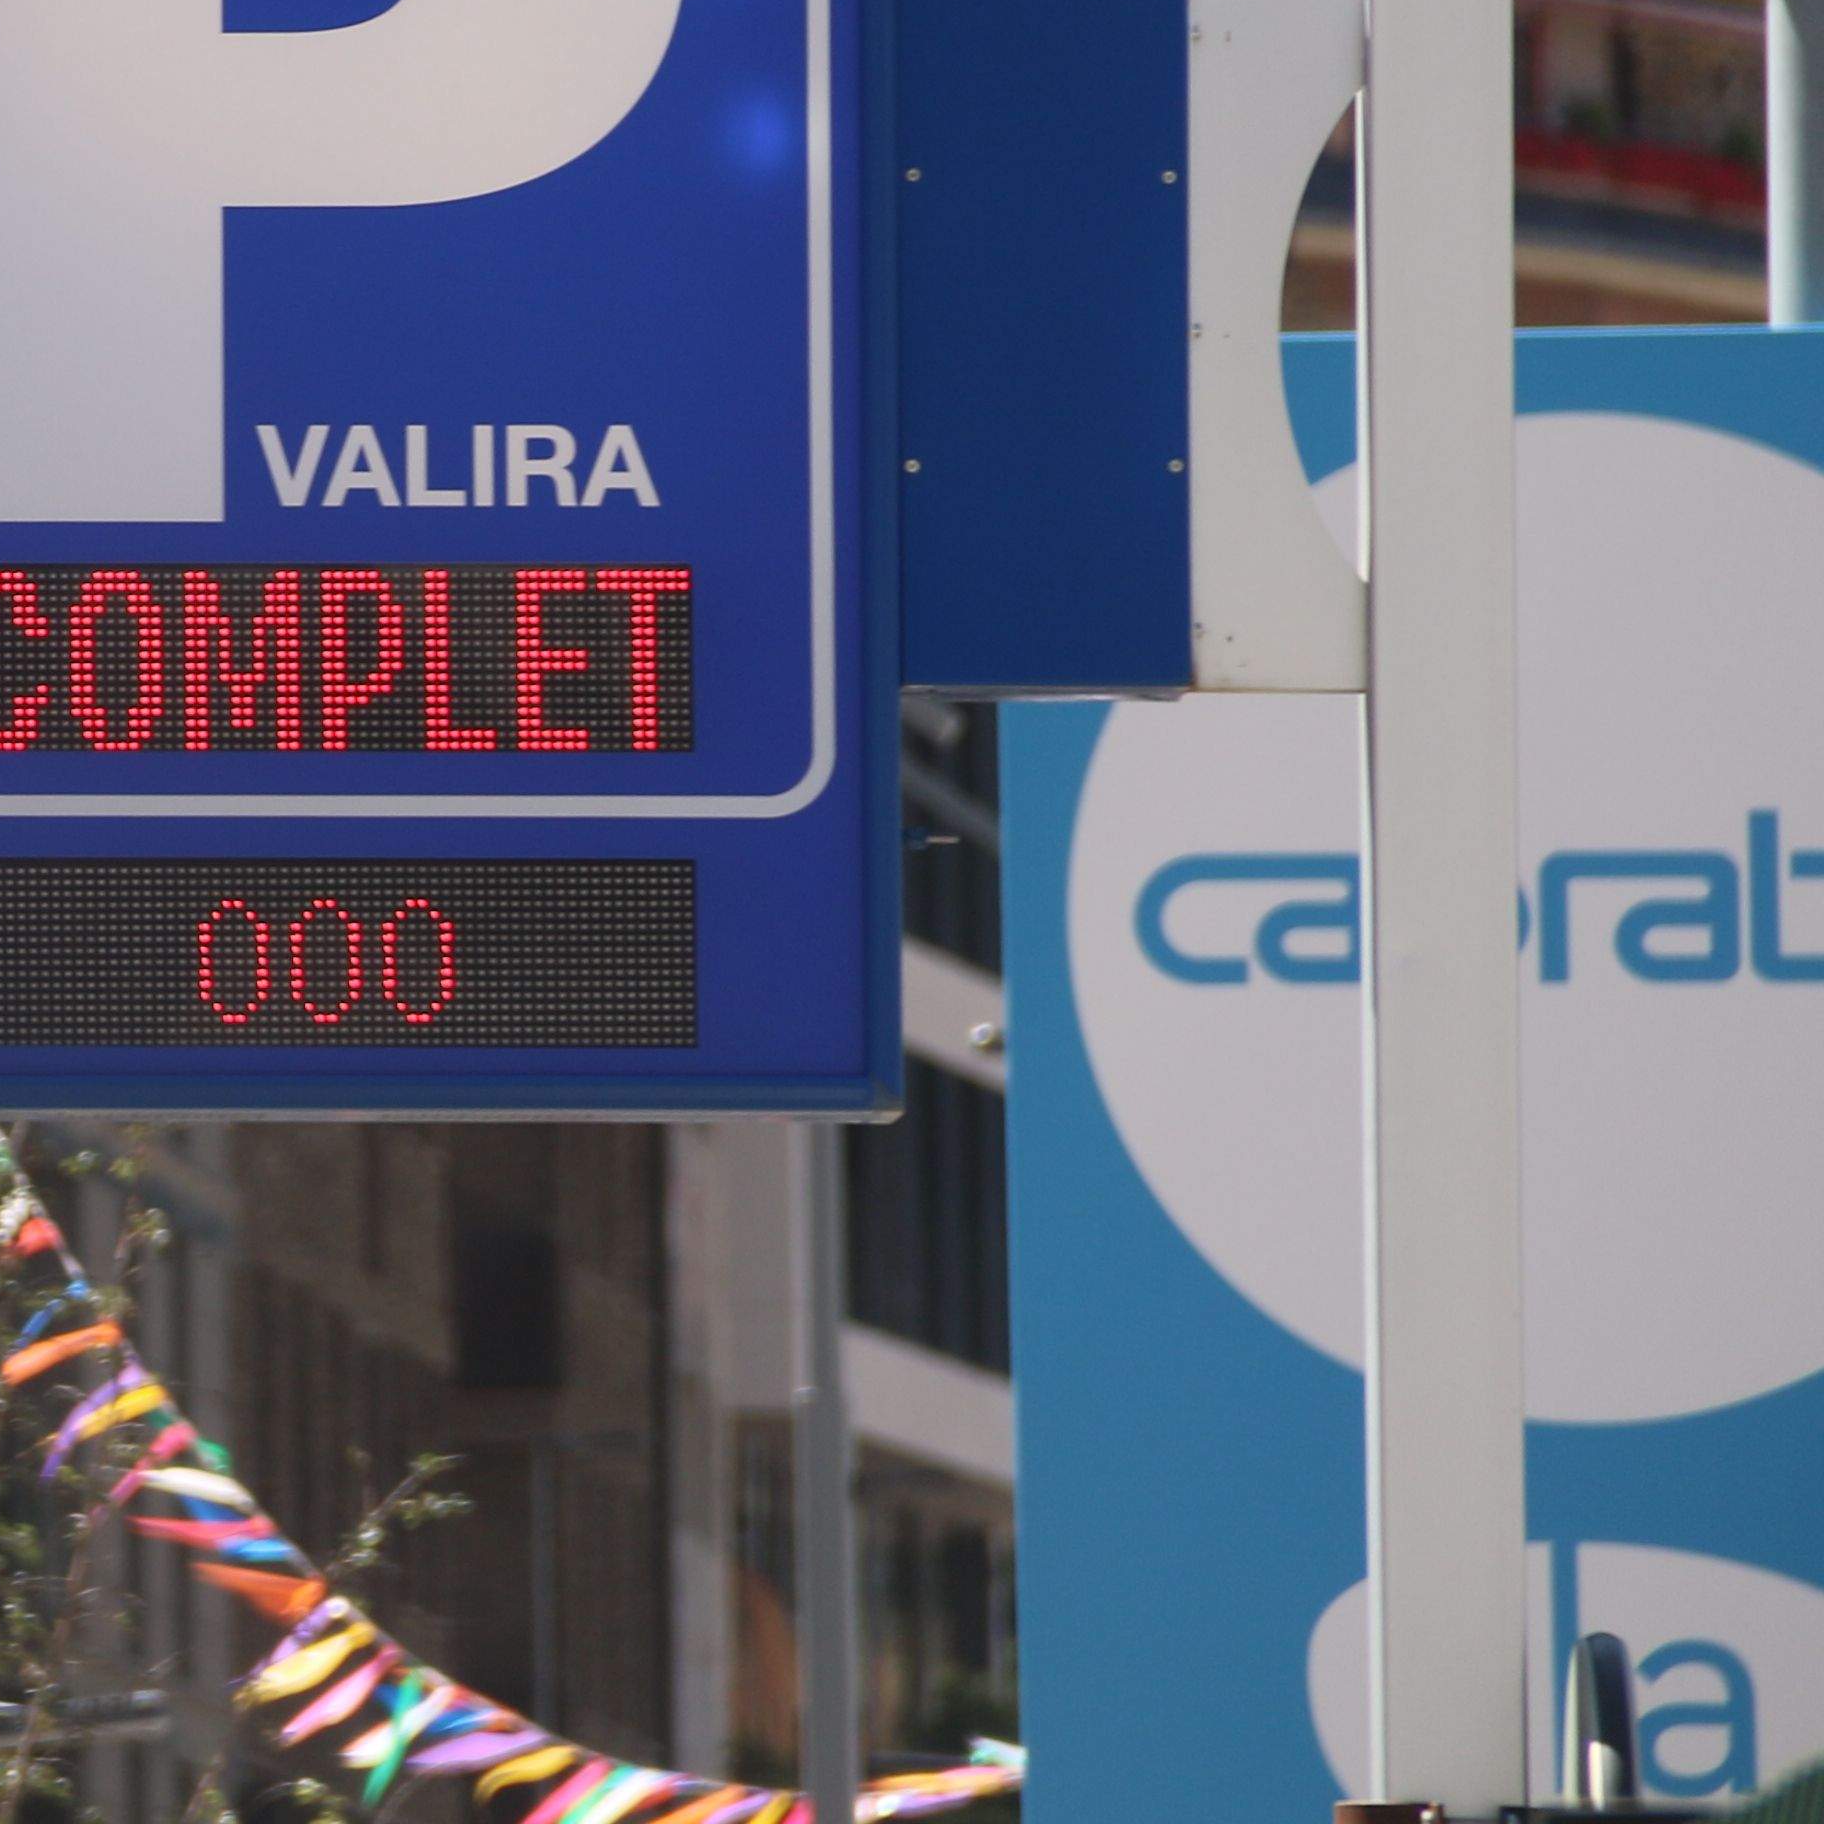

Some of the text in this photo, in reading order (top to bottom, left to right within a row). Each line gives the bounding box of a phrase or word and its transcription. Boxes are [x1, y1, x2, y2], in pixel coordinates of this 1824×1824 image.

[256, 424, 661, 508] VALIRA
[1133, 810, 1824, 984] carab
[197, 898, 456, 1024] 000
